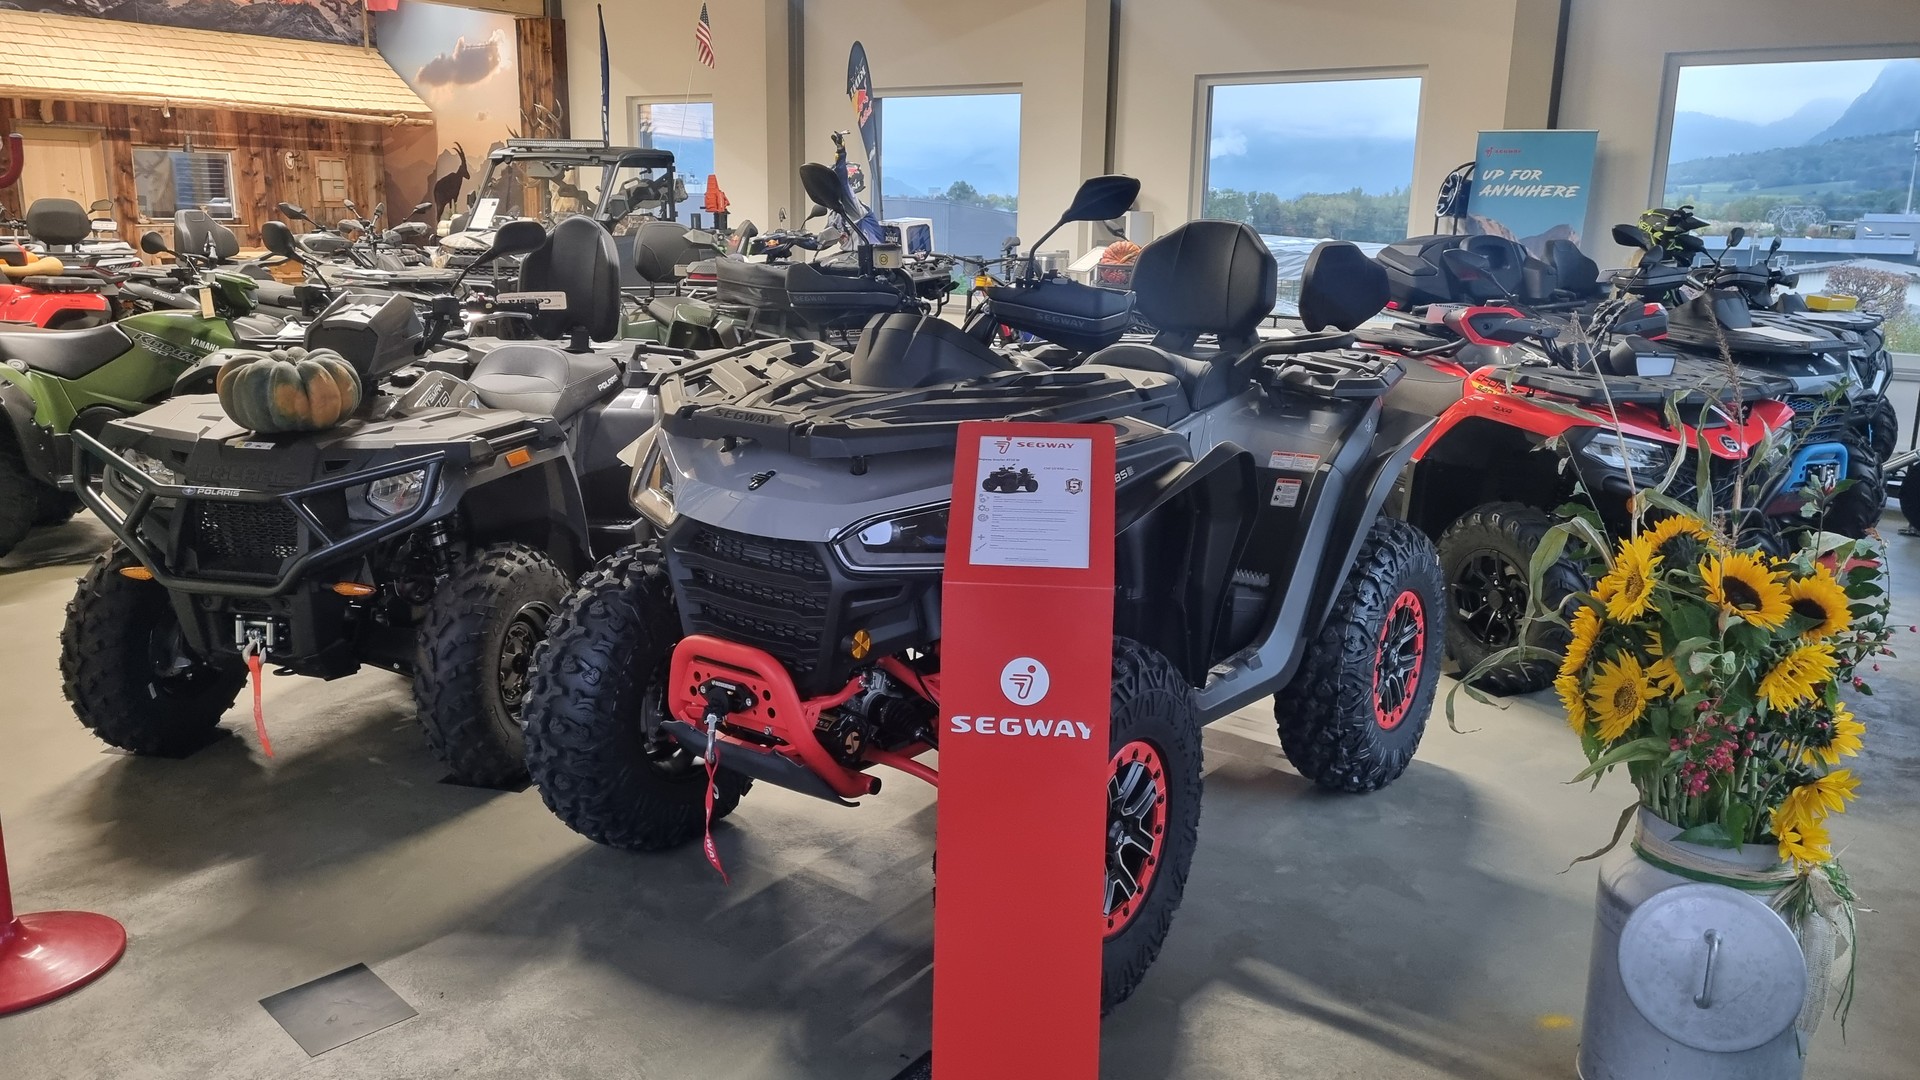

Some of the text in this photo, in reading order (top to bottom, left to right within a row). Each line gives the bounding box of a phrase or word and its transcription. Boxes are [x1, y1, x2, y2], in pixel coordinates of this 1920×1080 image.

[1482, 169, 1543, 181] UP FOR
[1478, 184, 1581, 198] ANYWHERE
[152, 290, 176, 301] CFMOTO
[1036, 312, 1085, 327] SEGWAY
[190, 337, 220, 351] YAMAHA
[714, 408, 775, 424] SEGWAY
[1016, 441, 1074, 449] SEGWAY
[197, 488, 240, 497] POLARIS
[950, 715, 1091, 740] SEGWAY
